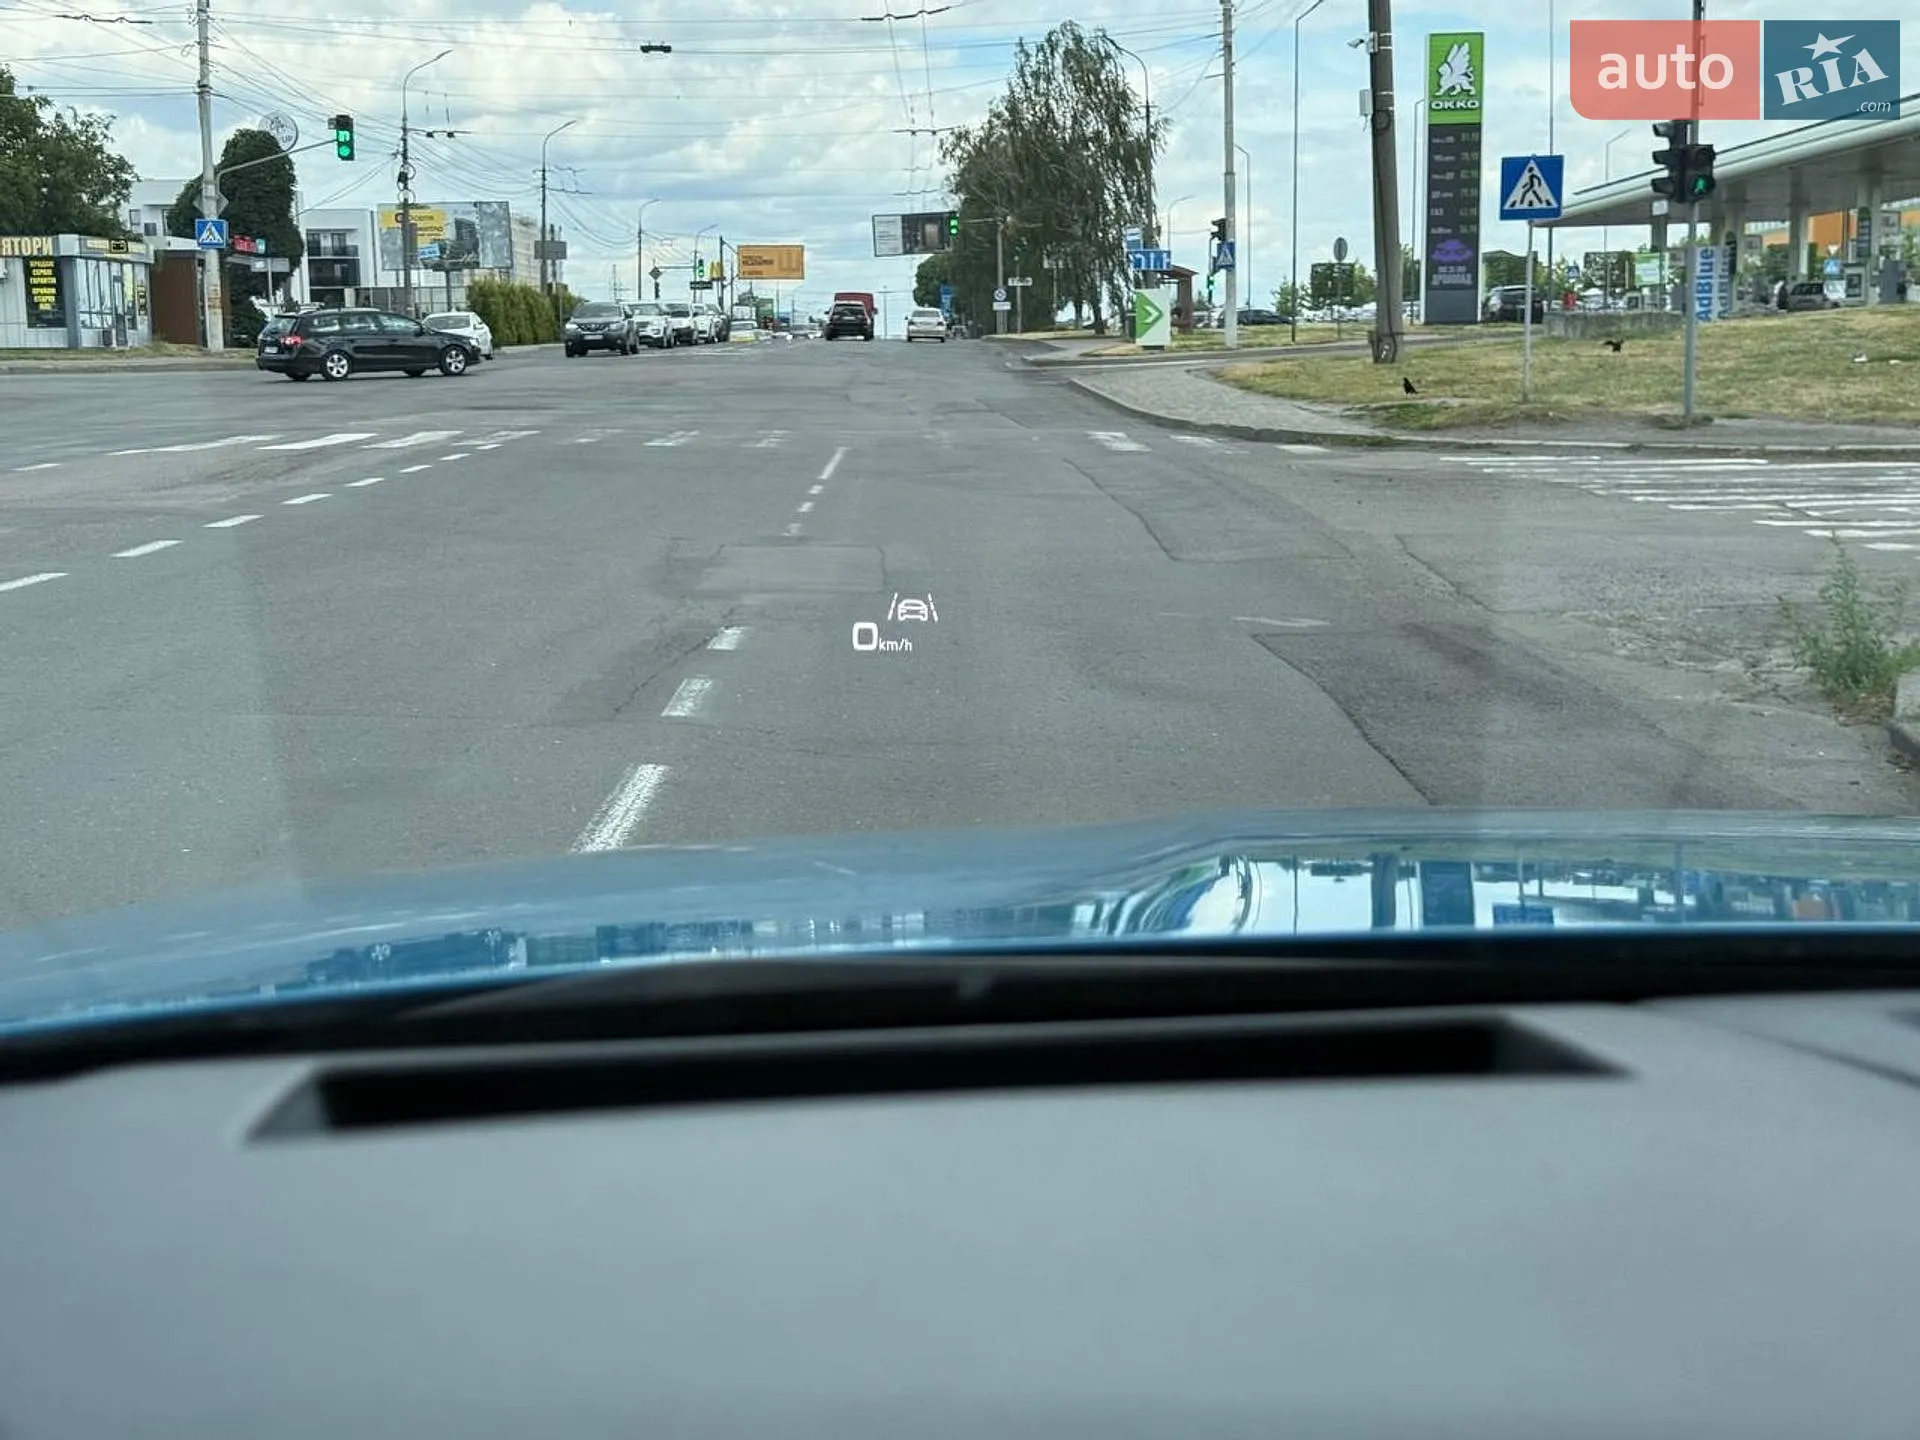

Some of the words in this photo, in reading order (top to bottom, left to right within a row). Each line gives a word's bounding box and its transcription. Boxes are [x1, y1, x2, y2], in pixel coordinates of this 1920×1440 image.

[1431, 100, 1480, 109] OKKO
[1, 236, 53, 256] ЯТОРИ
[1696, 248, 1715, 321] AdBlue
[852, 621, 878, 651] 0
[879, 637, 912, 652] km/h
